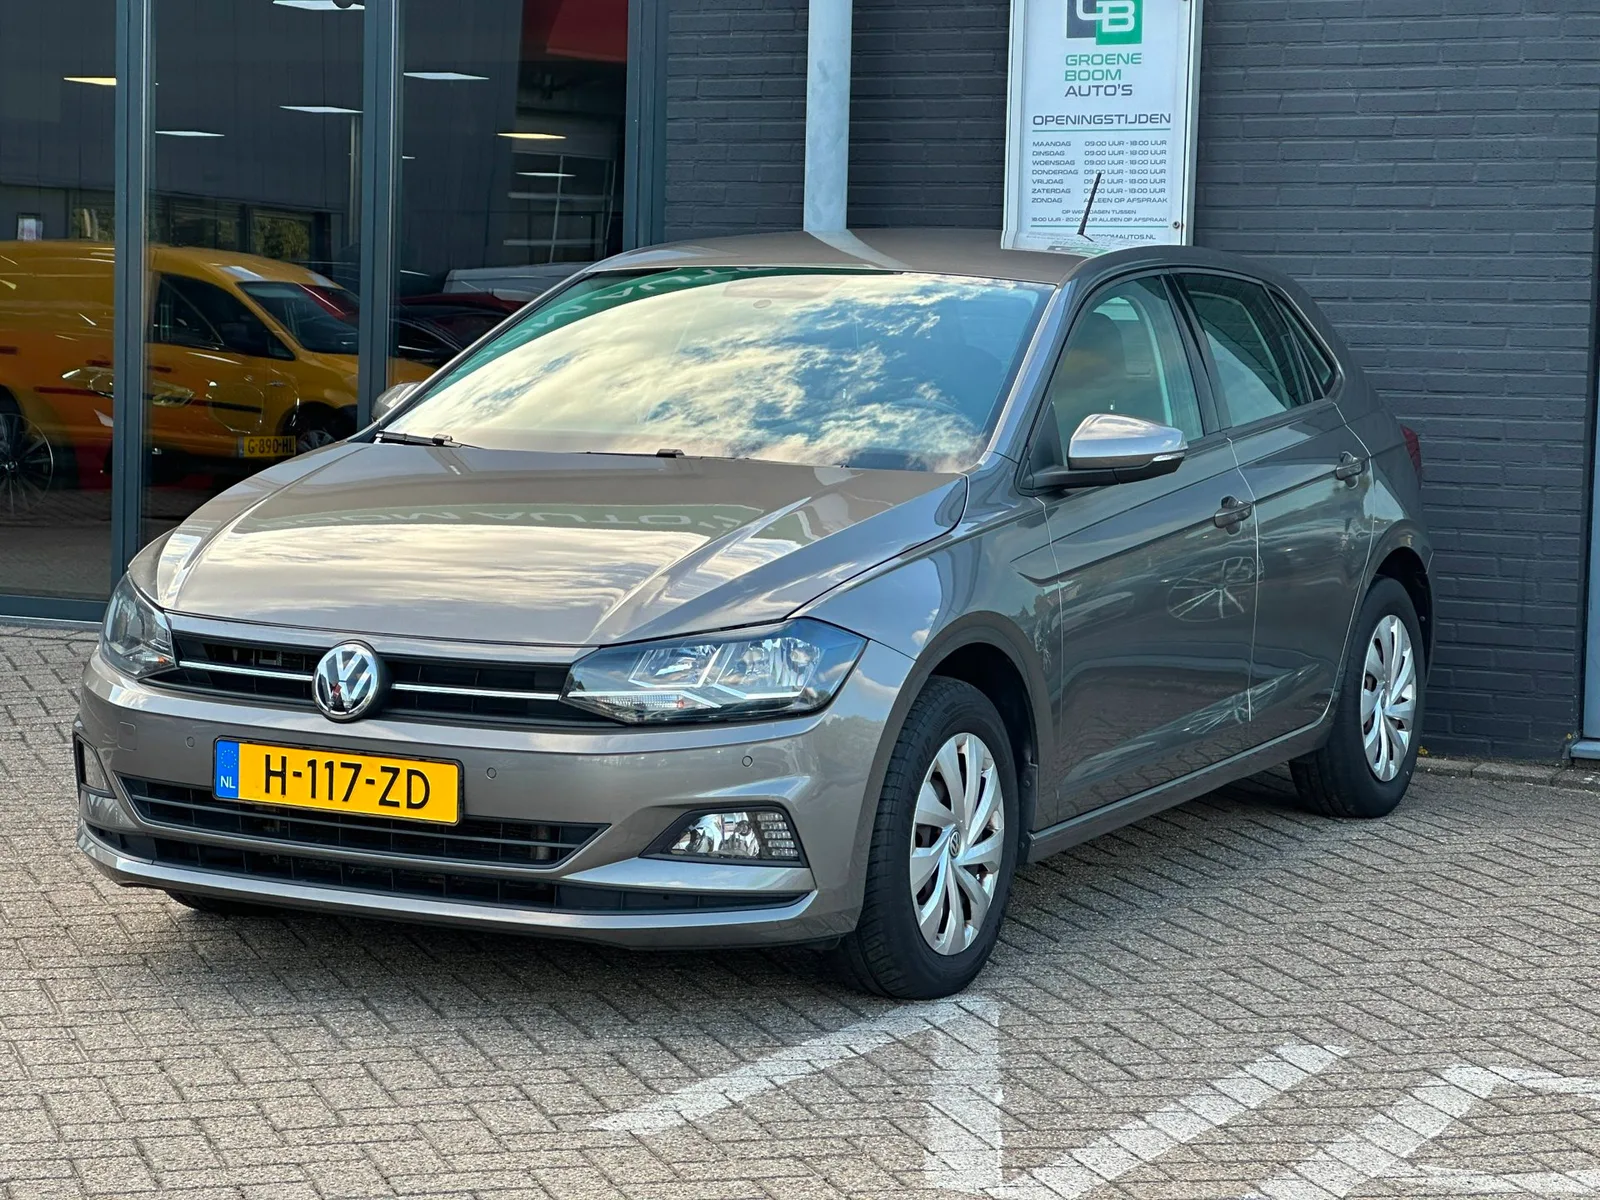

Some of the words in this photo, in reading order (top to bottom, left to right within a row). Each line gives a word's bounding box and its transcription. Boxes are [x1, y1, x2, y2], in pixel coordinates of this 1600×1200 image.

[1065, 53, 1143, 66] GROENE
[1065, 69, 1122, 81] BOOM
[1065, 84, 1133, 97] AUTO'S
[1032, 113, 1172, 125] OPENINGSTIJDEN
[248, 439, 295, 455] G-890-HL
[220, 775, 237, 789] NL
[264, 754, 431, 810] H-117-ZD
